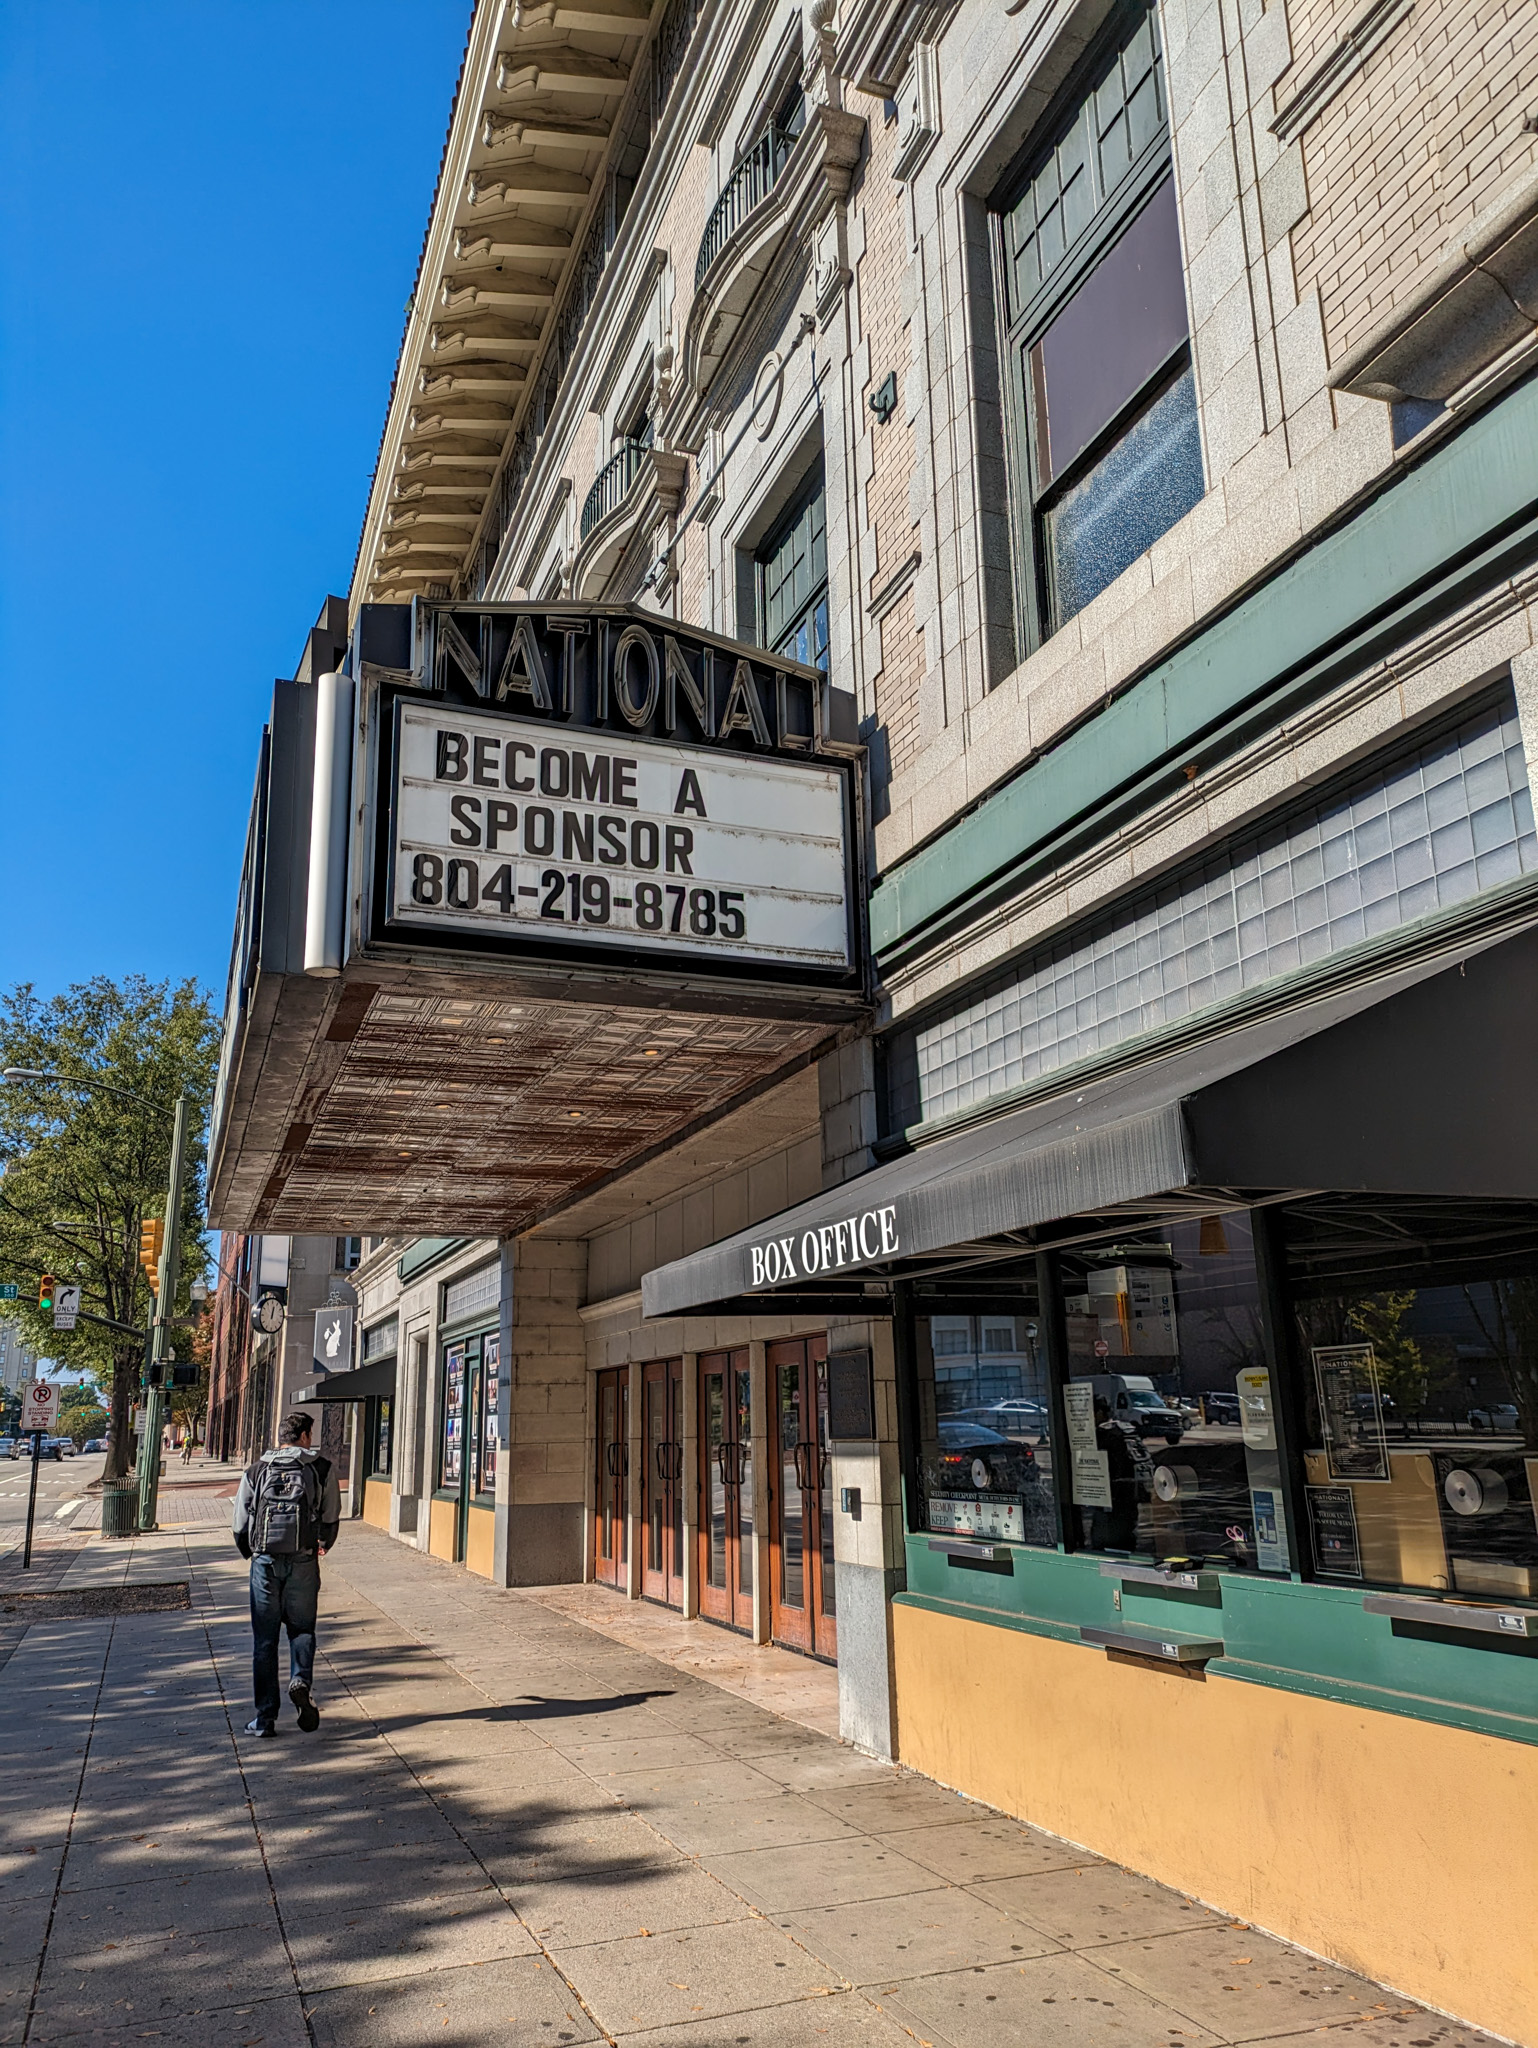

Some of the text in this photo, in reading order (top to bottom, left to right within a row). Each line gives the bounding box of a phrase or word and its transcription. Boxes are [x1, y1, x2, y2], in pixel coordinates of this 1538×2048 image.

[434, 612, 815, 753] NATIONAL
[435, 730, 708, 818] BECOME A
[450, 795, 695, 875] SPONSOR
[412, 852, 745, 939] 804-219-8785
[751, 1205, 899, 1286] BOX OFFICE
[3, 1285, 16, 1294] St
[930, 1501, 958, 1514] REMOVE
[931, 1515, 949, 1526] KEEP
